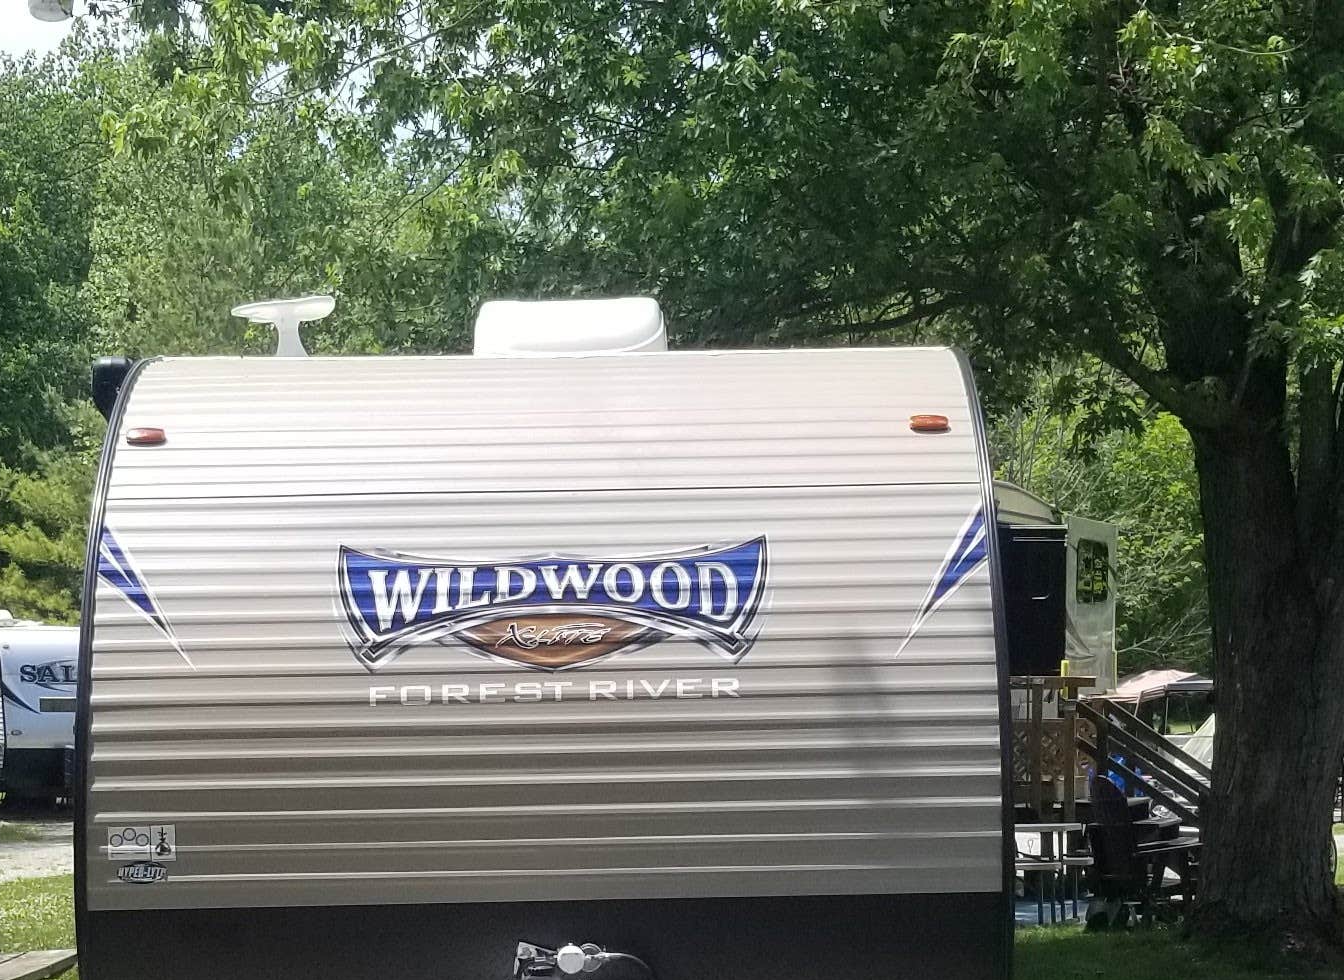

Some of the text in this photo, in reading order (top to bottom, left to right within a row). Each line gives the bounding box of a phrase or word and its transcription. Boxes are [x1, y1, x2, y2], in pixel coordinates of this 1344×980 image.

[368, 561, 739, 631] WILDWOOD
[369, 677, 742, 707] FOREST RIVER
